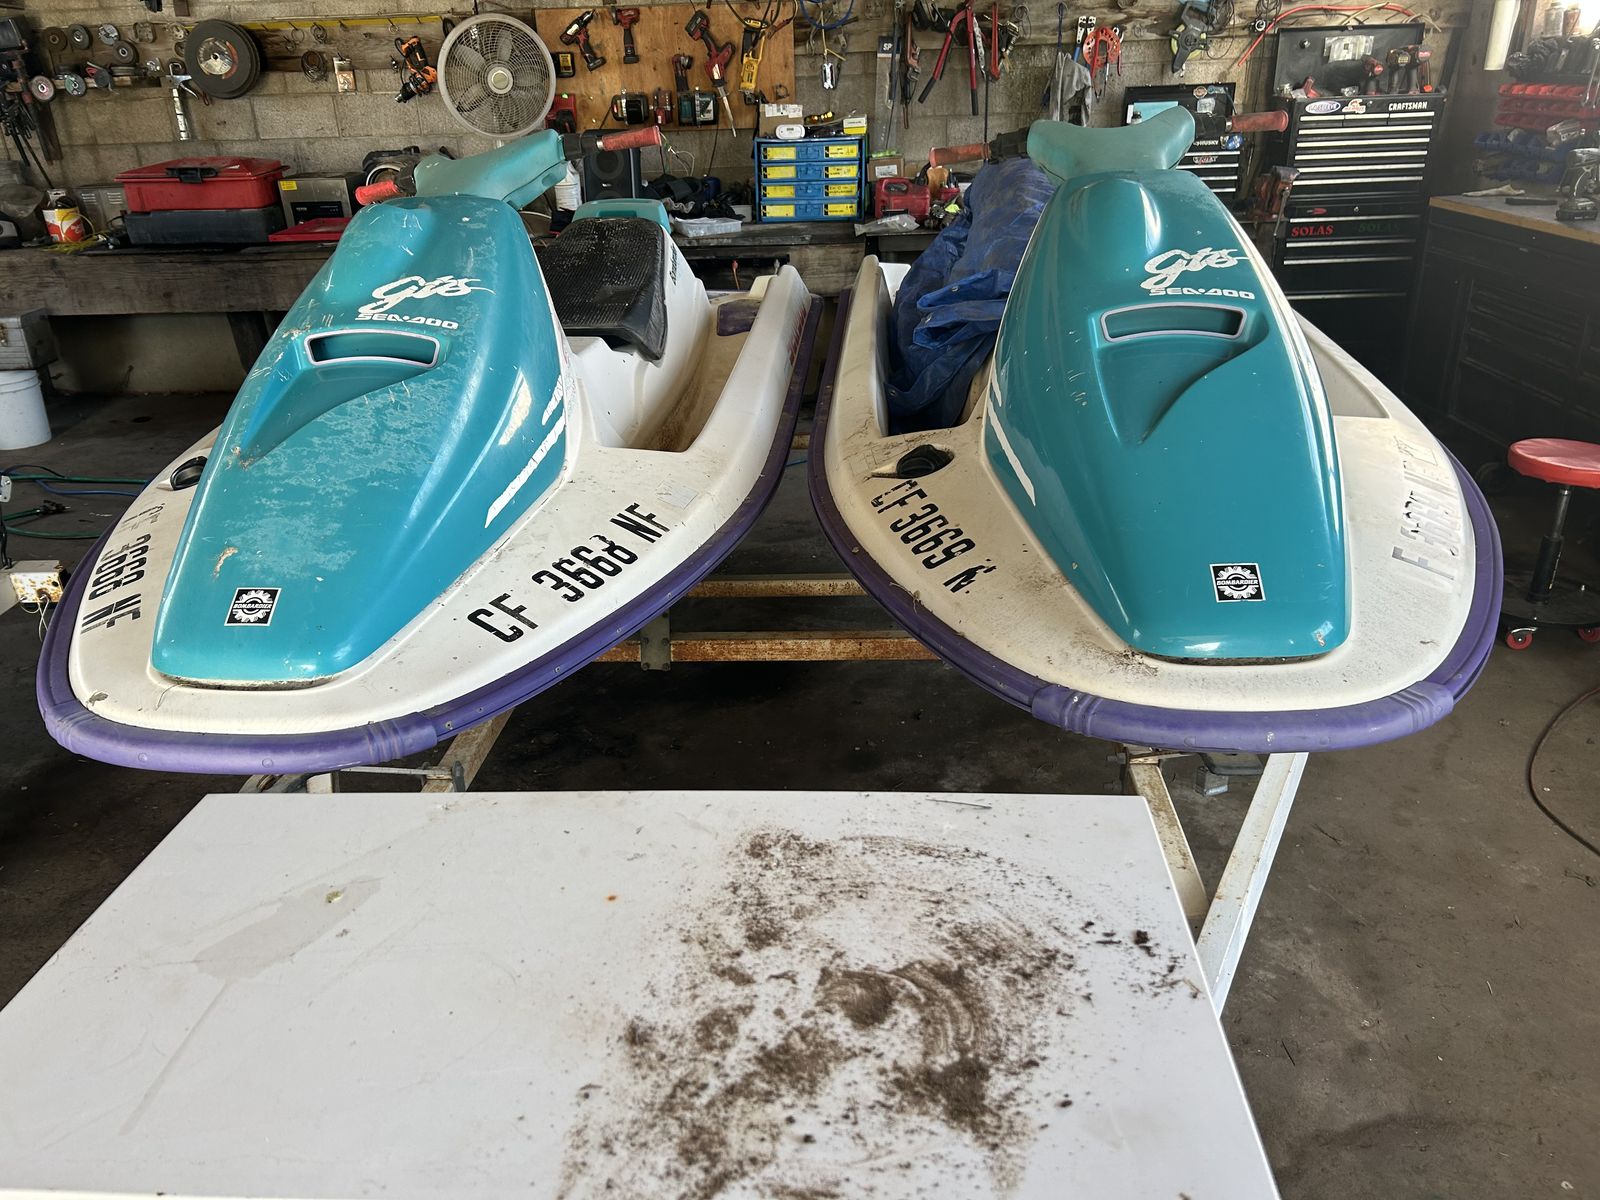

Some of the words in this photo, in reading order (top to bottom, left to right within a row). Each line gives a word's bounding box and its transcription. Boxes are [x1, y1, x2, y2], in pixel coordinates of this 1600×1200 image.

[1388, 101, 1428, 111] CRAFTSMAN
[1291, 225, 1334, 237] SOLAS
[889, 503, 976, 569] 3669
[467, 592, 539, 643] CF
[531, 534, 639, 603] 3668
[609, 502, 671, 544] NF
[80, 593, 142, 635] NF
